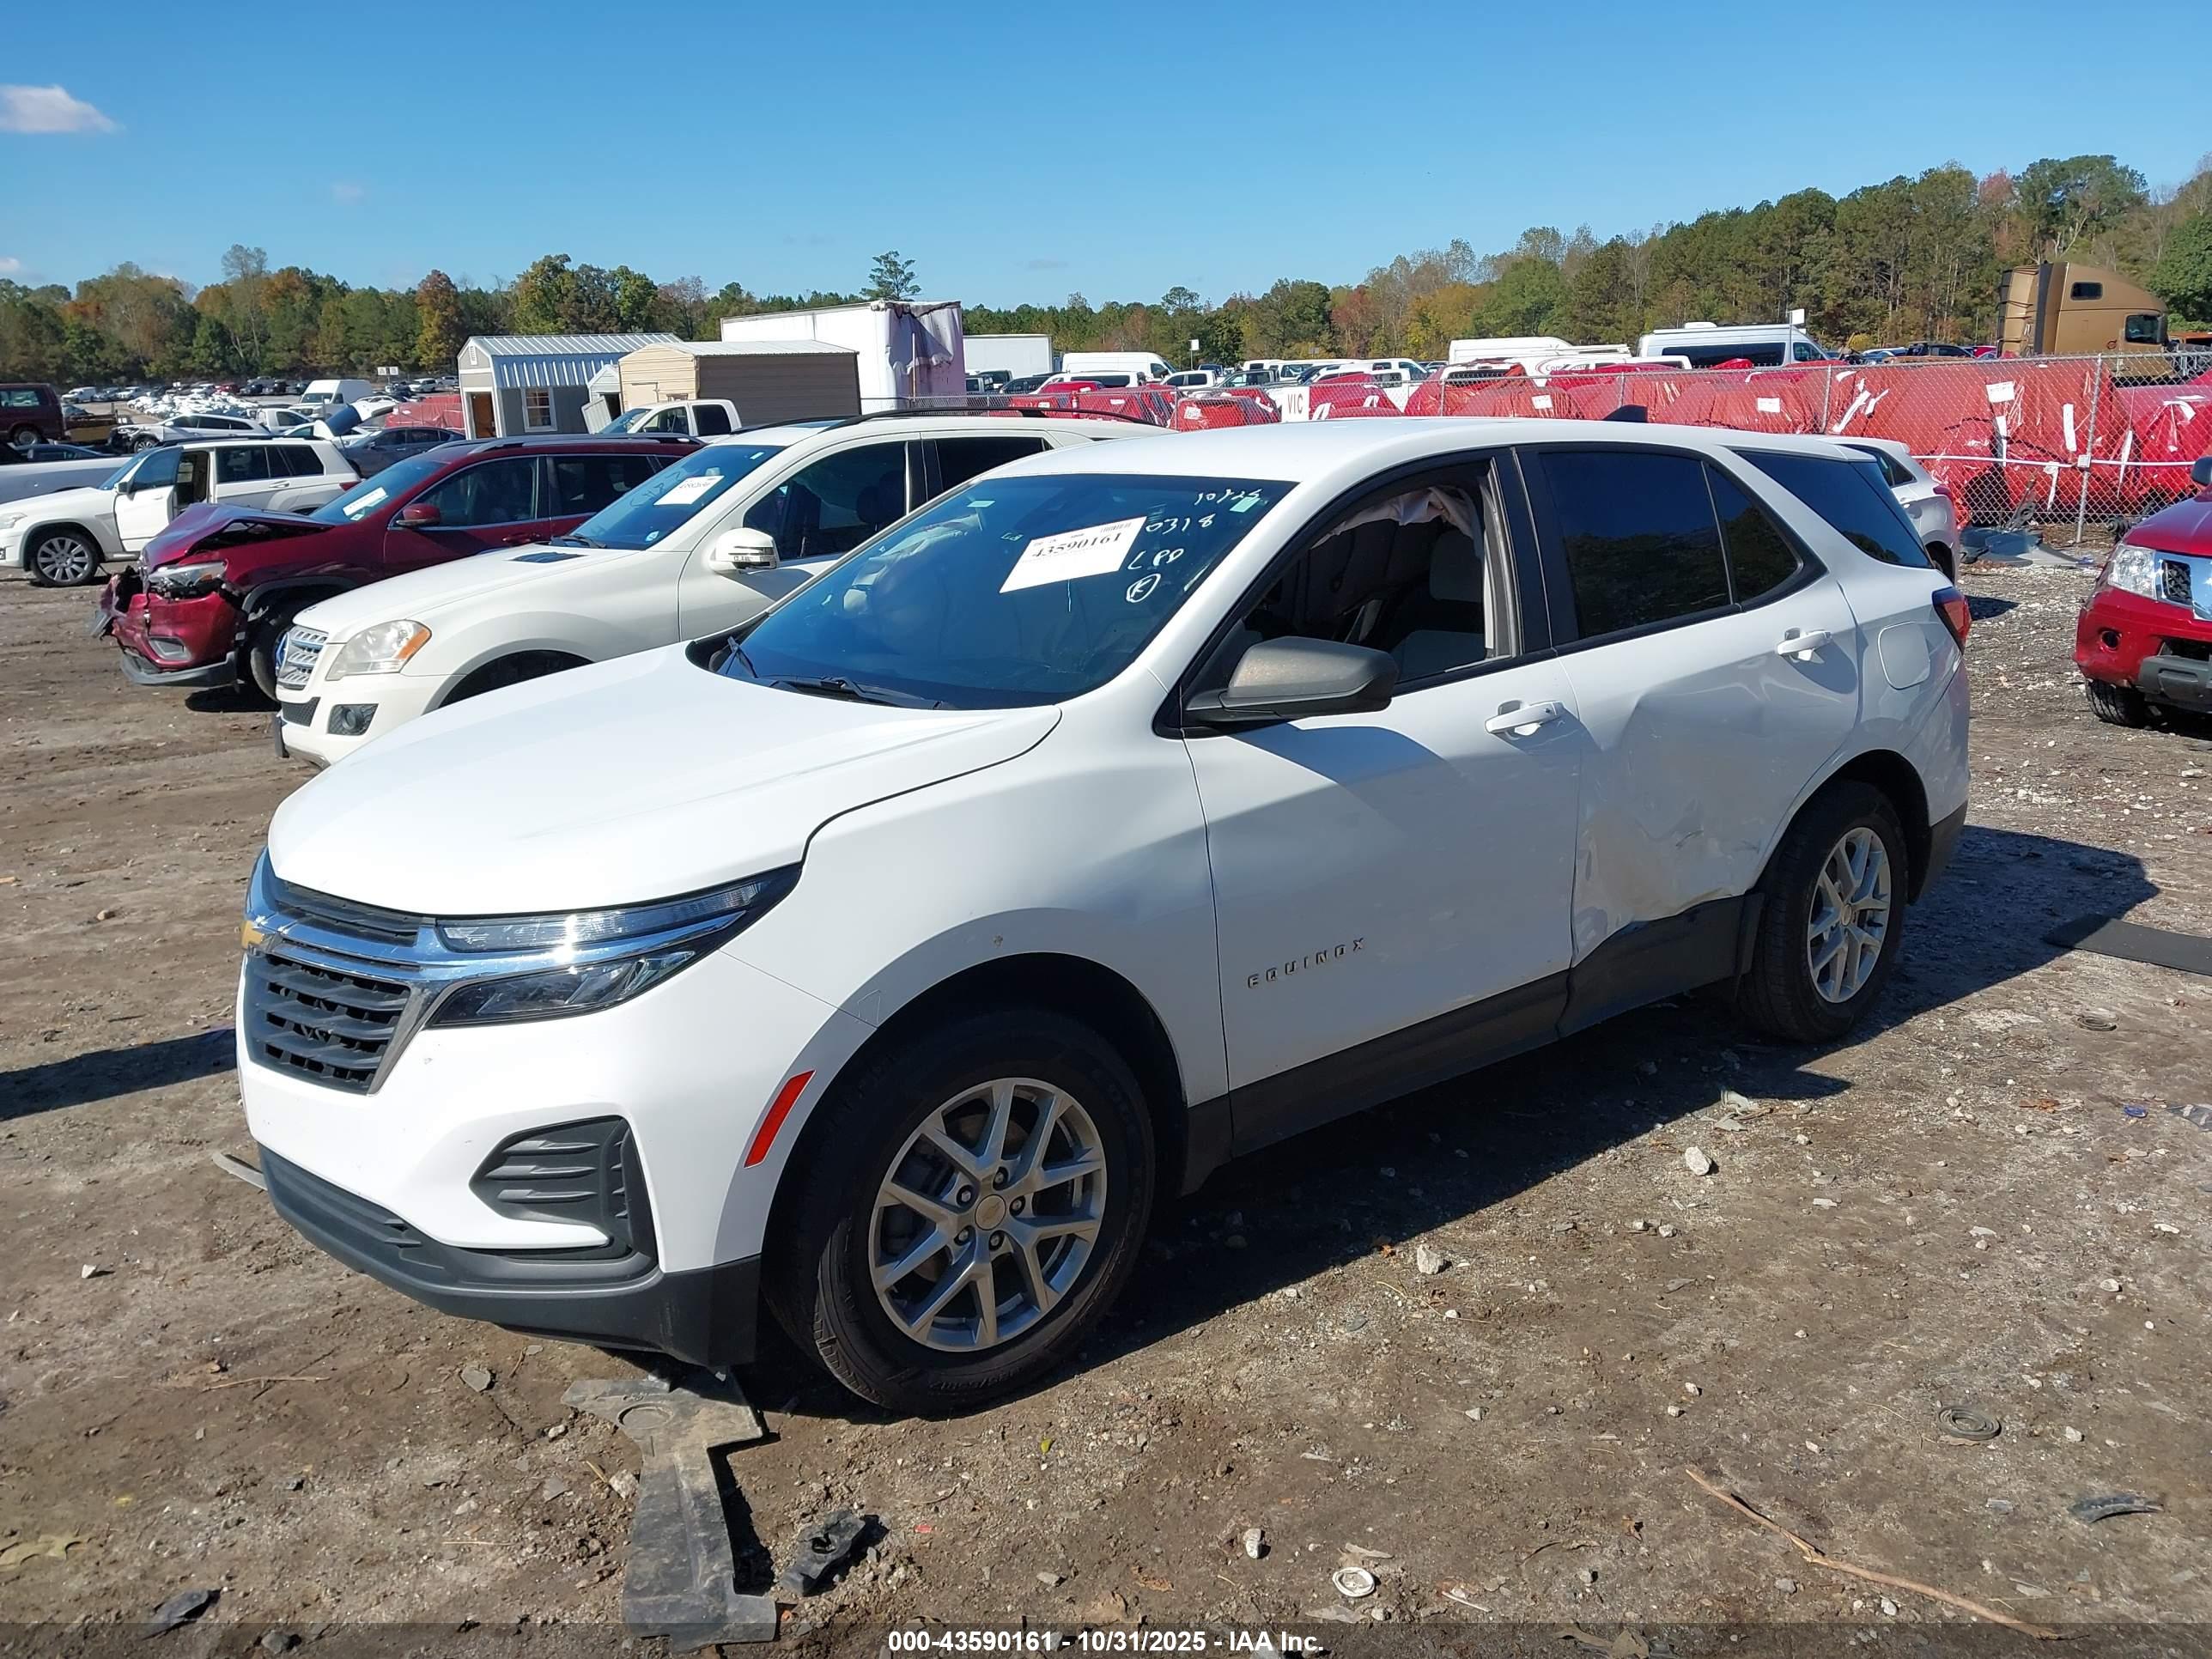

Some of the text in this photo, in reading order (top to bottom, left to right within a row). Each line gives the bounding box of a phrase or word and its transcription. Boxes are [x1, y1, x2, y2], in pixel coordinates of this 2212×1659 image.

[1287, 393, 1304, 414] VIC
[1146, 513, 1217, 535] 0318
[1032, 532, 1121, 557] 43590161
[1247, 937, 1364, 989] EQUINOX
